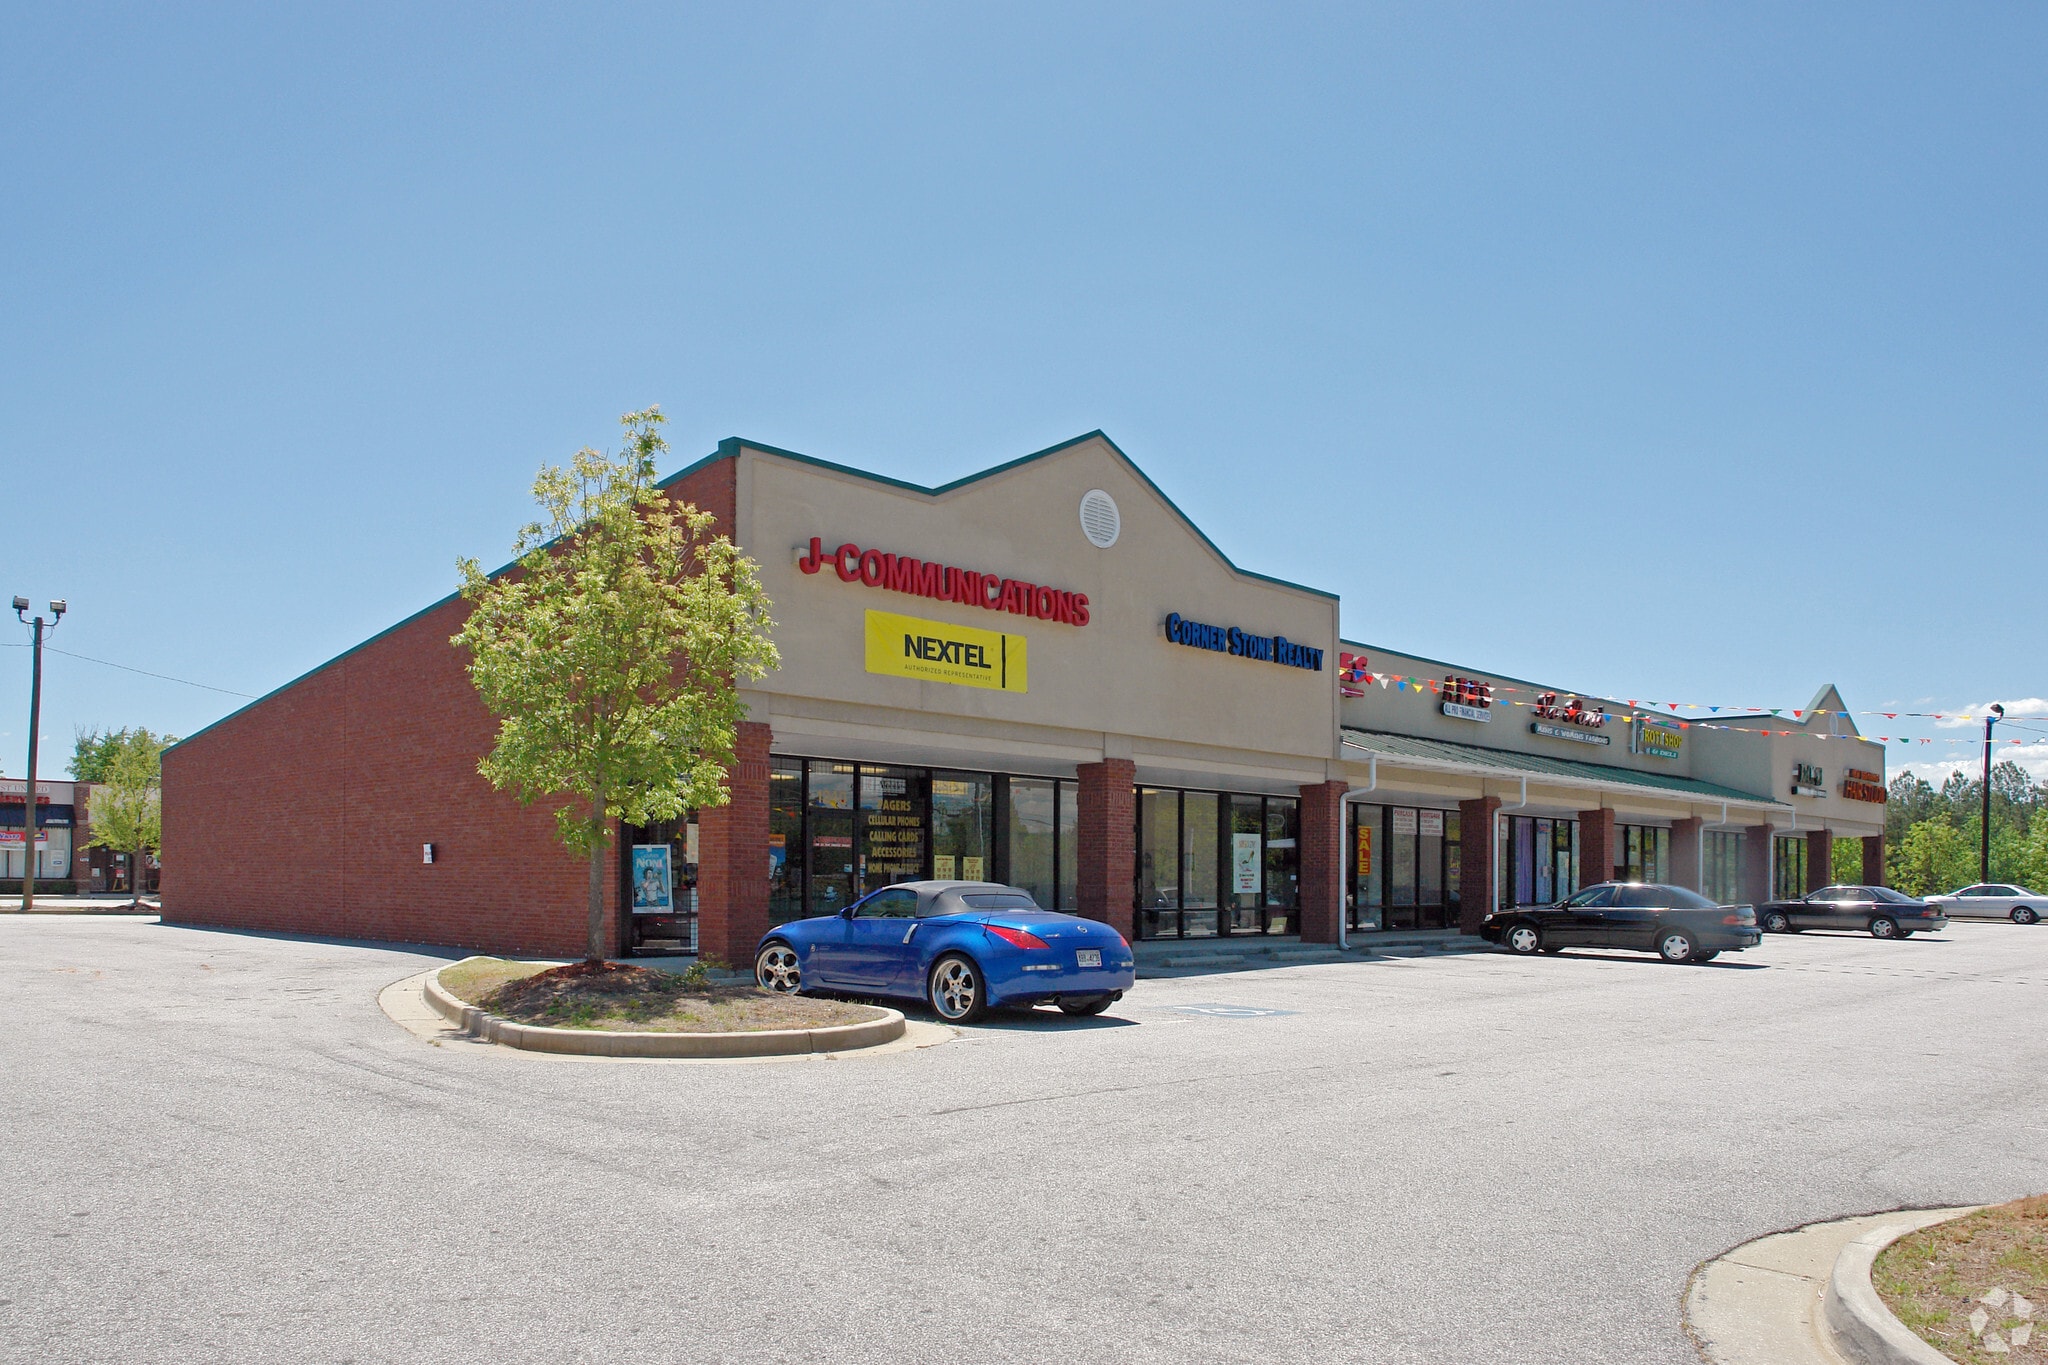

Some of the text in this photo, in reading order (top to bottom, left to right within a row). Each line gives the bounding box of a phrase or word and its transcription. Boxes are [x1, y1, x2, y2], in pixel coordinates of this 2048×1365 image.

[799, 537, 1090, 627] J-COMMUNICATIONS
[1165, 612, 1324, 671] CORNER STONE REALTY
[904, 634, 992, 669] NEXTEL
[904, 664, 992, 682] AUTHORIZED REPRESENTATIVE
[1663, 732, 1683, 748] SHOP
[14, 784, 48, 792] UNED
[877, 799, 912, 811] PAGERS
[868, 815, 920, 827] CELLULAR PHONES
[869, 830, 919, 842] CALLING CARDS
[871, 846, 917, 858] ACCESSORIES
[1359, 829, 1370, 873] SALE
